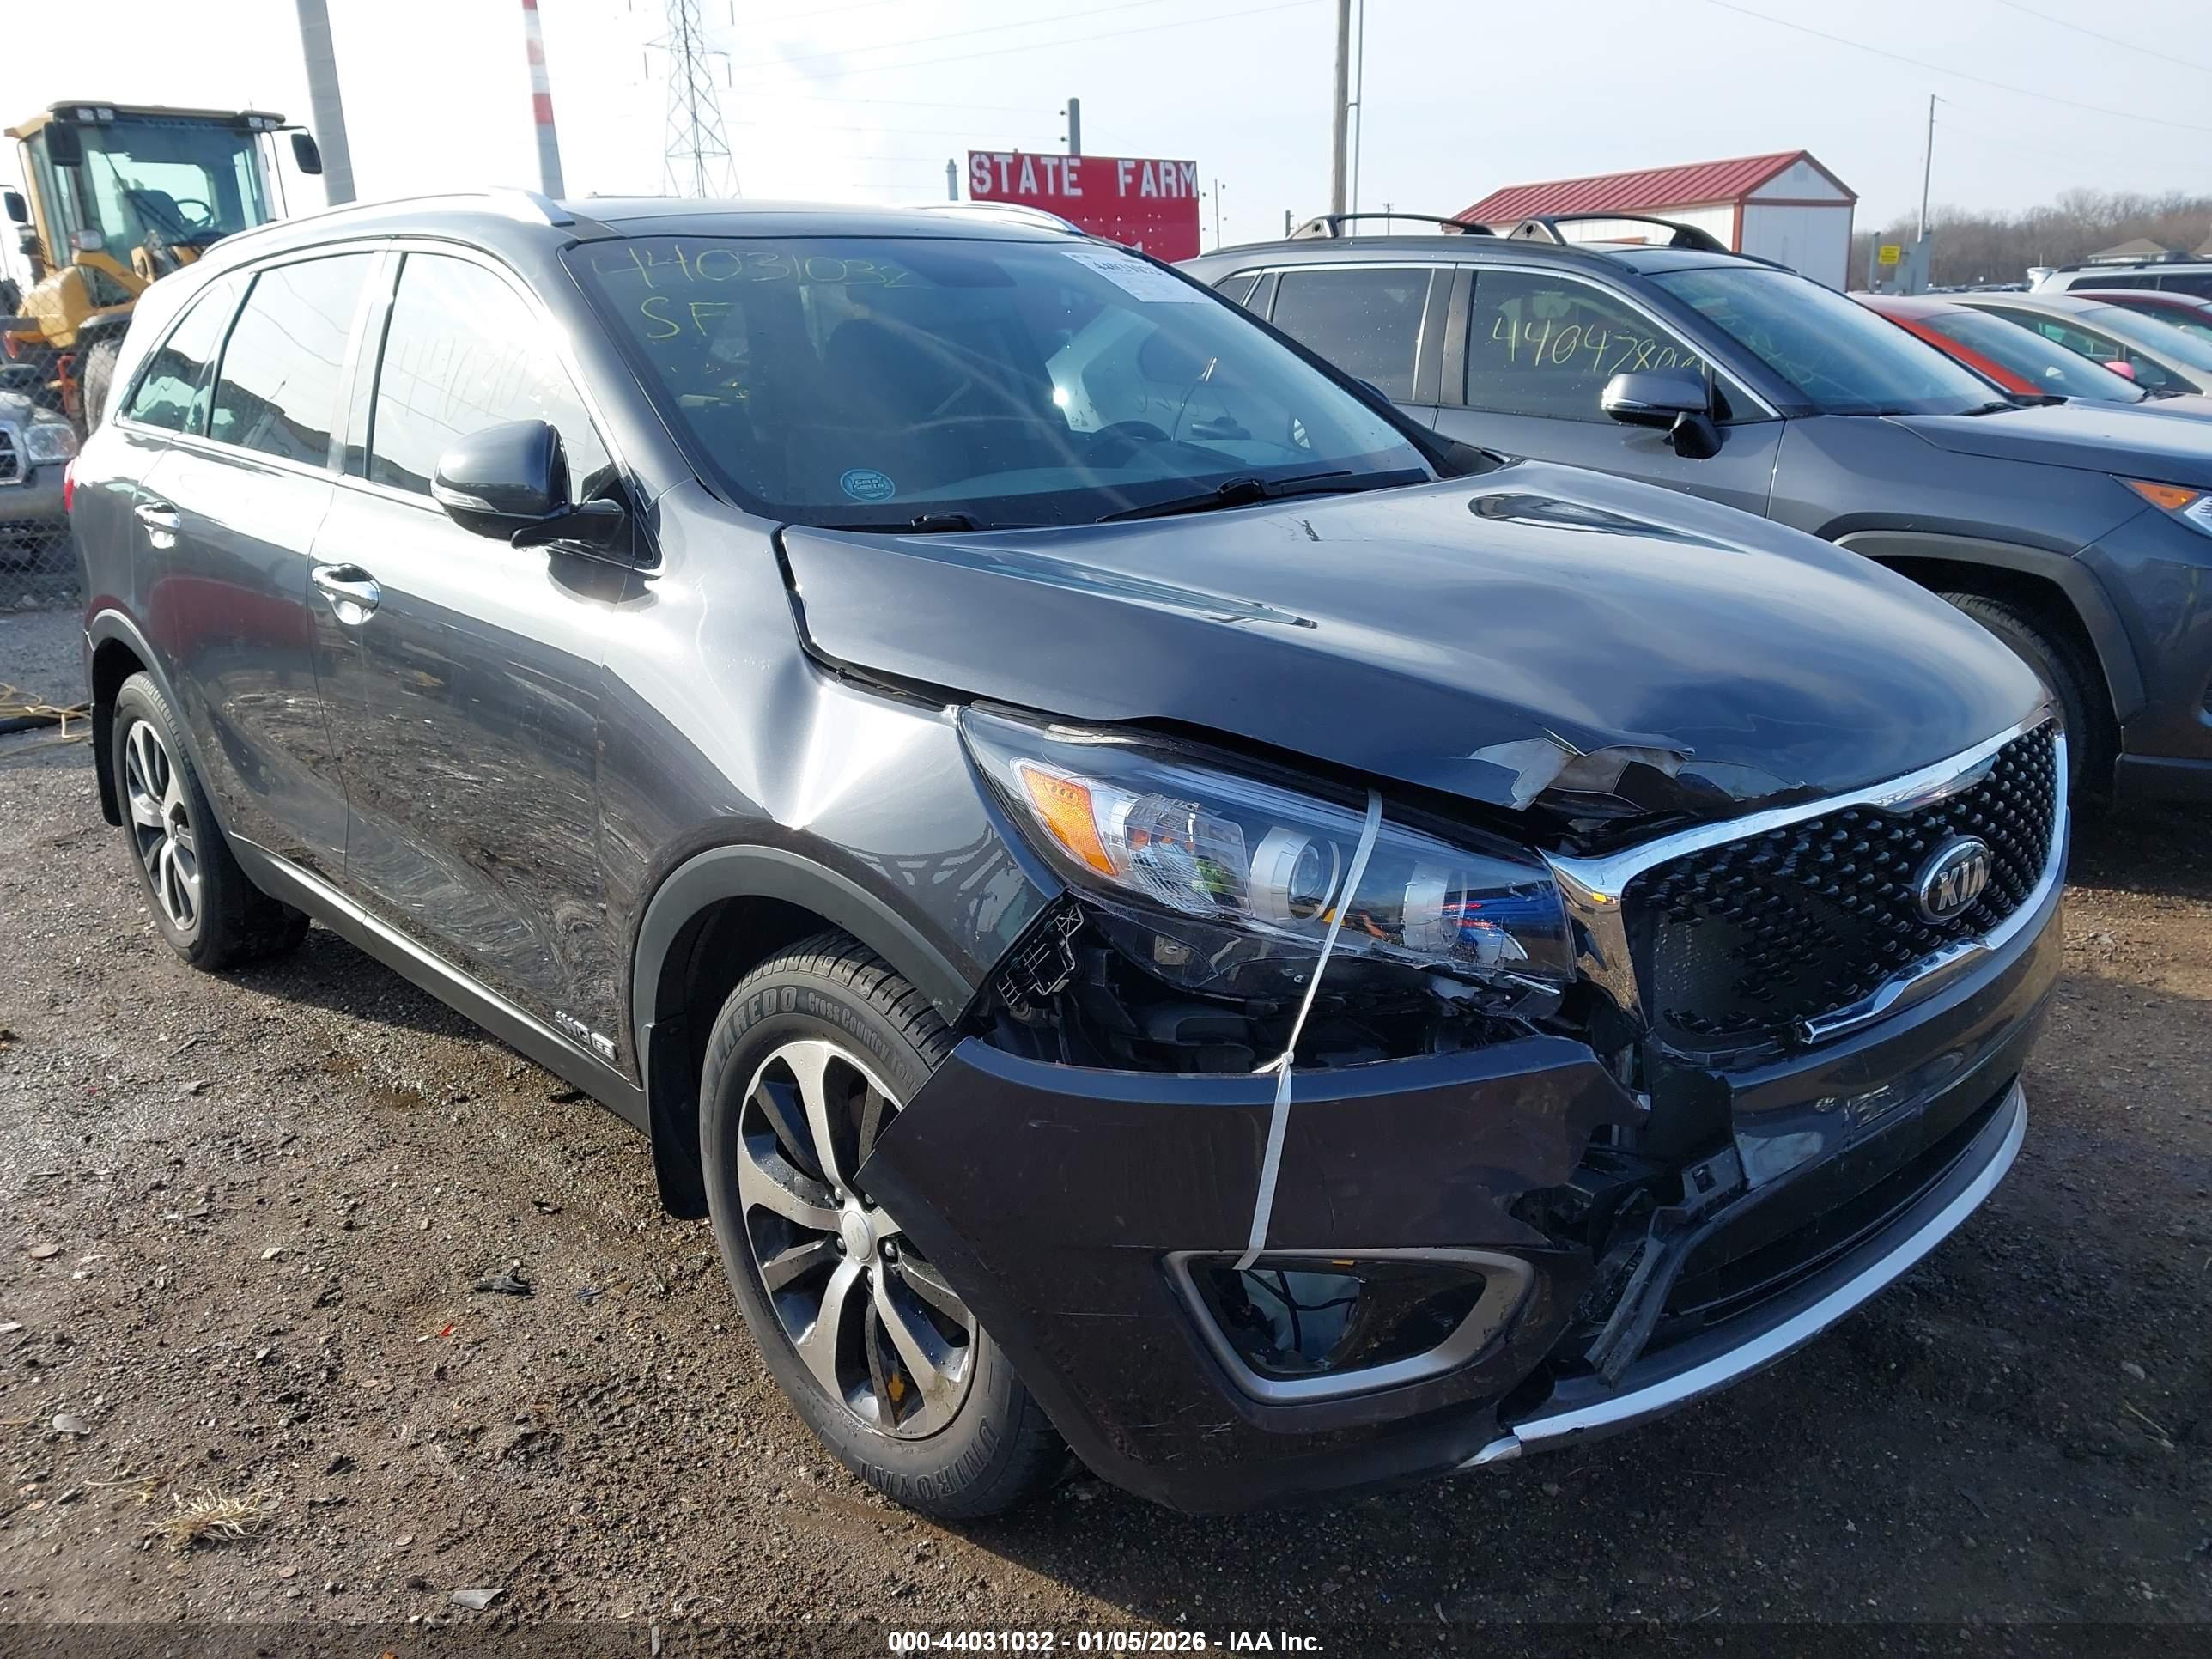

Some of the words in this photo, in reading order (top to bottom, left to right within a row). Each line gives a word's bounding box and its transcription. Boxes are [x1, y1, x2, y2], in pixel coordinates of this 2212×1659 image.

[970, 154, 1083, 197] STATE
[1117, 159, 1198, 198] FARM
[591, 245, 933, 289] 44031032
[639, 295, 733, 340] SF
[1937, 855, 1985, 912] KIA
[713, 986, 798, 1073] LAREDO
[808, 992, 840, 1024] Cross
[842, 1008, 891, 1064] Country
[854, 1416, 1001, 1500] UNIROYAL
